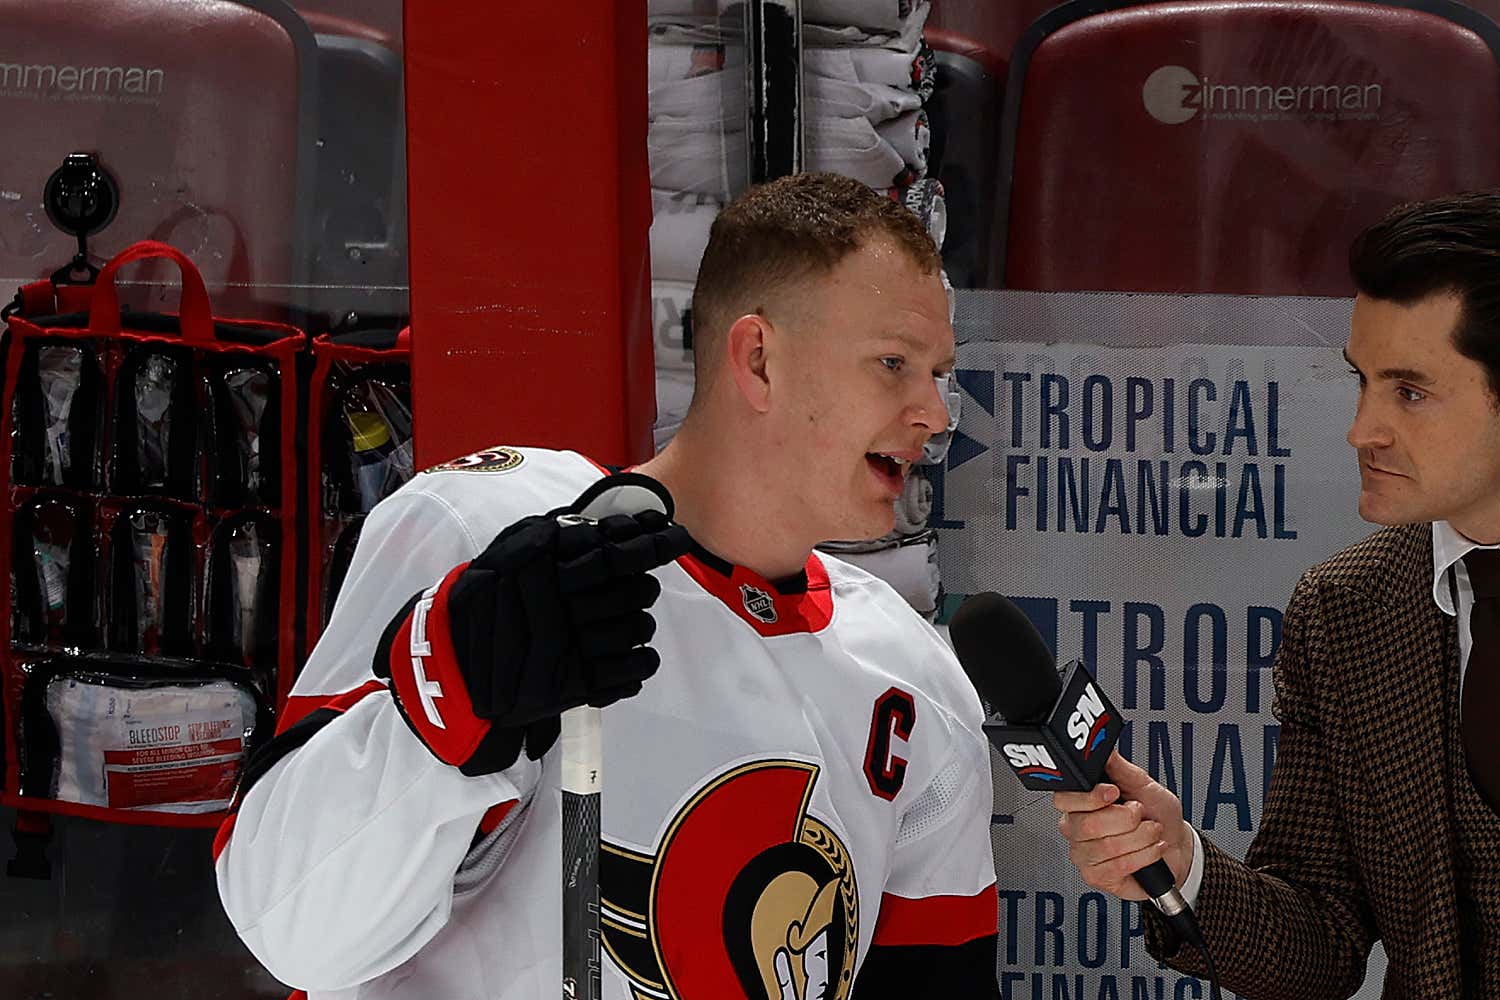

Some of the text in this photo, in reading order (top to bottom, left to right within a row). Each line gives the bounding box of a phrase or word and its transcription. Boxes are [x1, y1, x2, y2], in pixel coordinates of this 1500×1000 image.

[1180, 77, 1382, 111] zimmerman
[1003, 371, 1291, 457] TROPICAL
[1005, 455, 1298, 540] FINANCIAL
[863, 687, 916, 802] C
[1066, 681, 1106, 751] SN
[1002, 743, 1058, 768] SN
